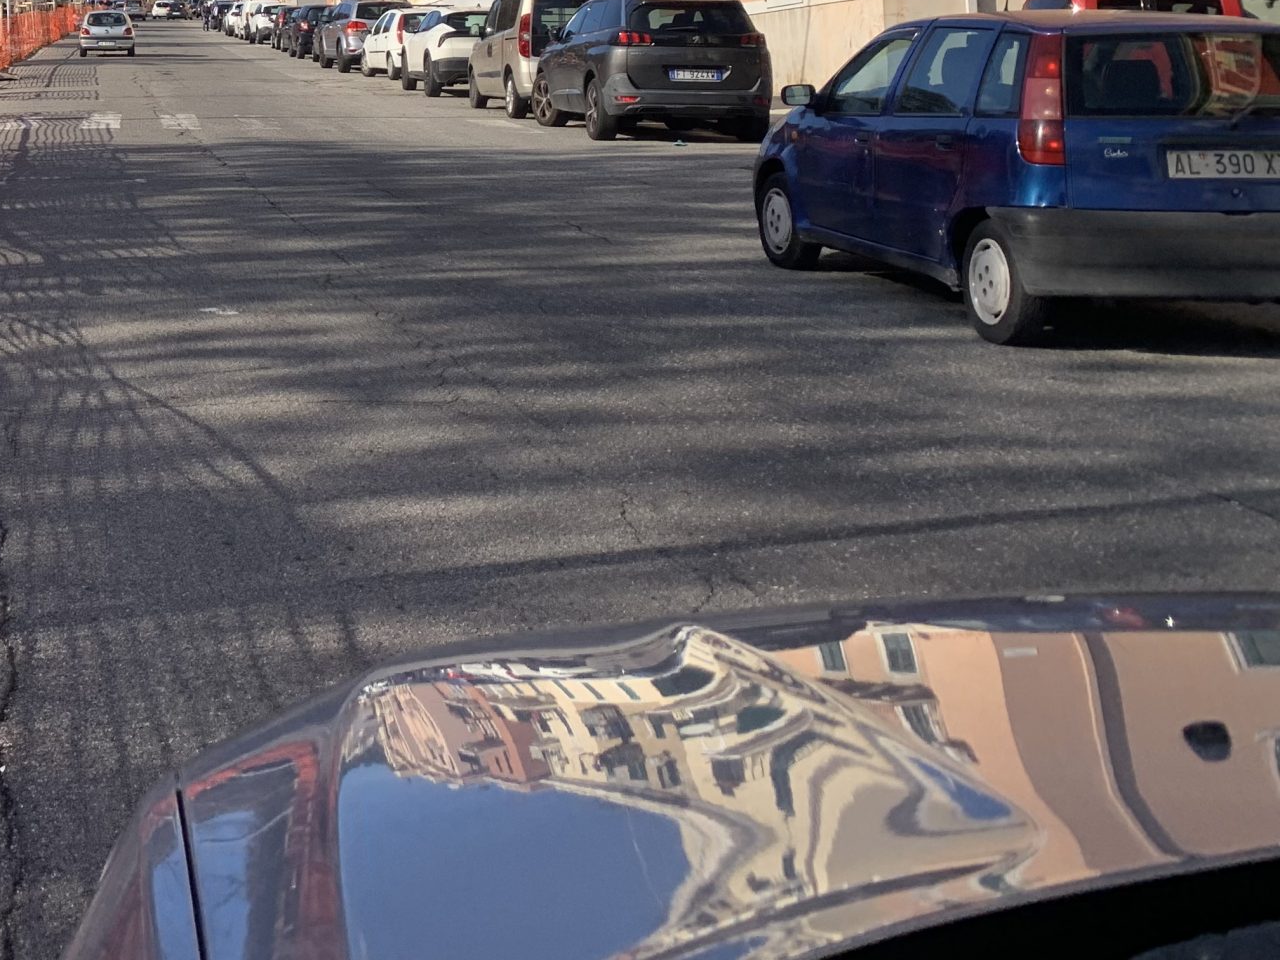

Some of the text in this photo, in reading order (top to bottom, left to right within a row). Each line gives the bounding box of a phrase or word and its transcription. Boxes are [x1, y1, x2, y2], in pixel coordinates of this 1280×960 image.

[1175, 153, 1280, 175] AL 390 X
